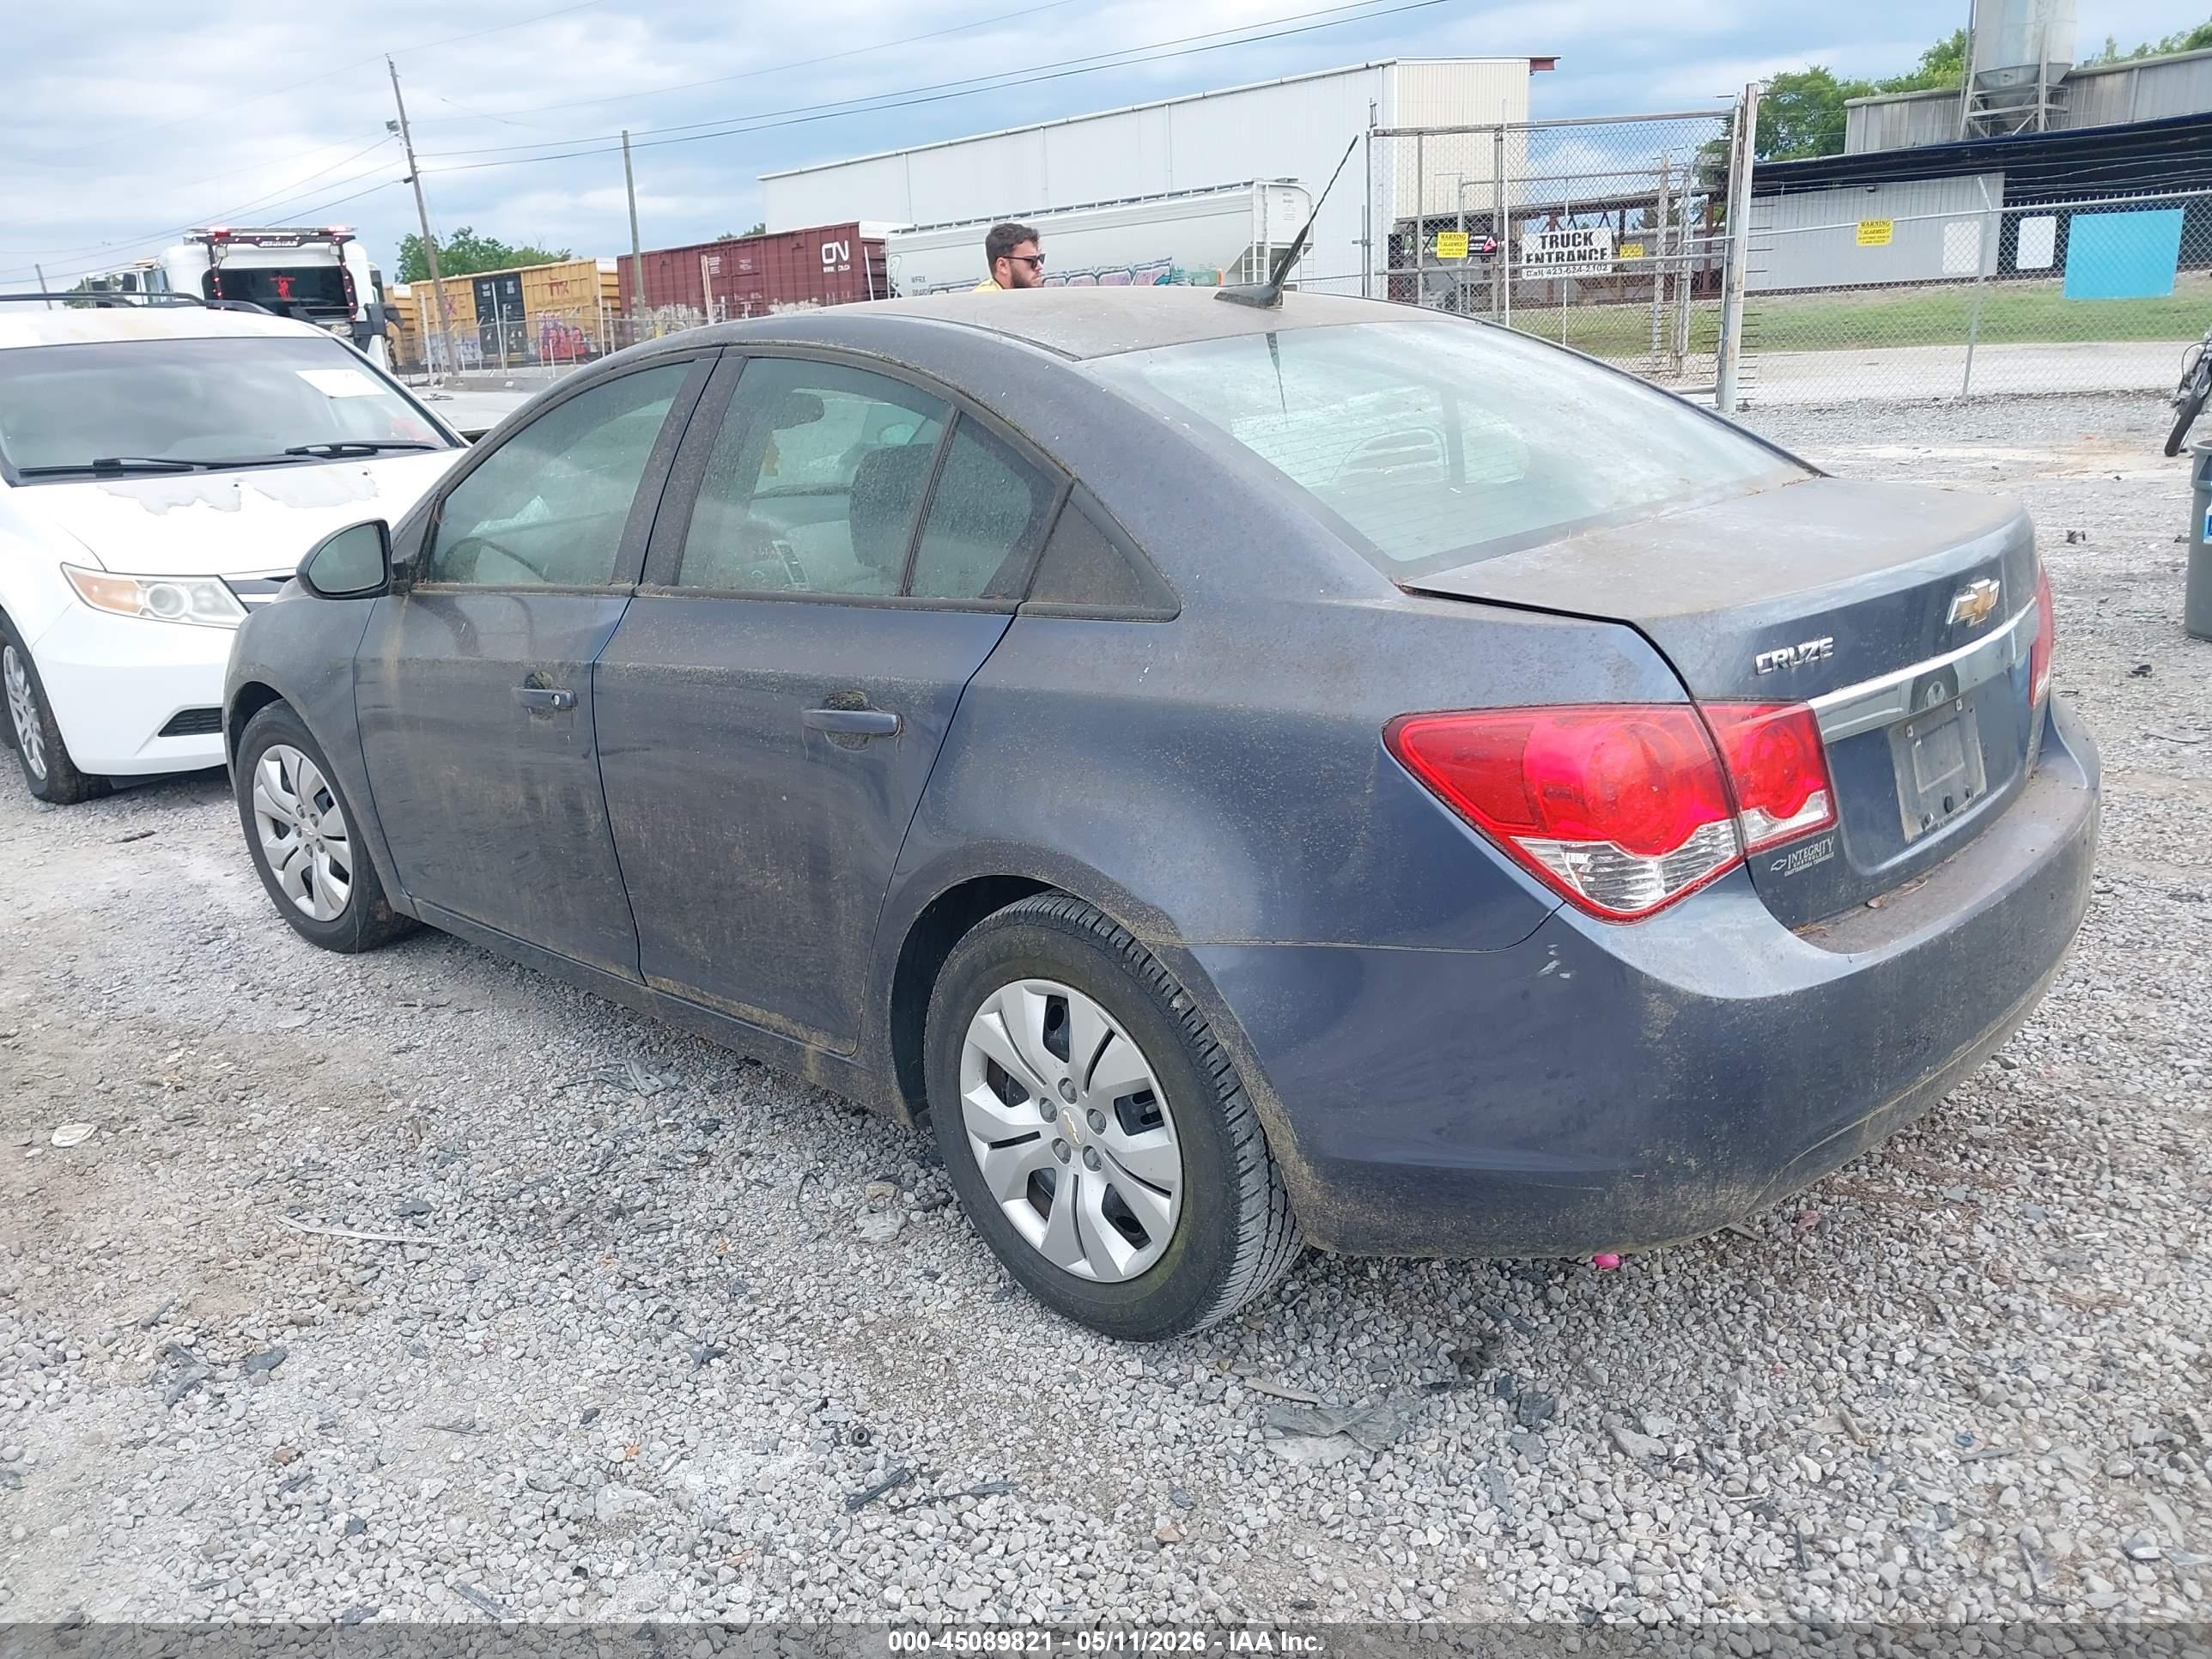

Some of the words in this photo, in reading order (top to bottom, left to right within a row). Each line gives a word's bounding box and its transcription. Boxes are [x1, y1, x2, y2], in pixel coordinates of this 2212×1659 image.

[821, 240, 850, 264] CN
[1539, 232, 1595, 250] TRUCK
[1525, 247, 1608, 264] ENTRANCE
[1755, 636, 1834, 676] CRUZE
[1788, 836, 1835, 870] INTEGRITY
